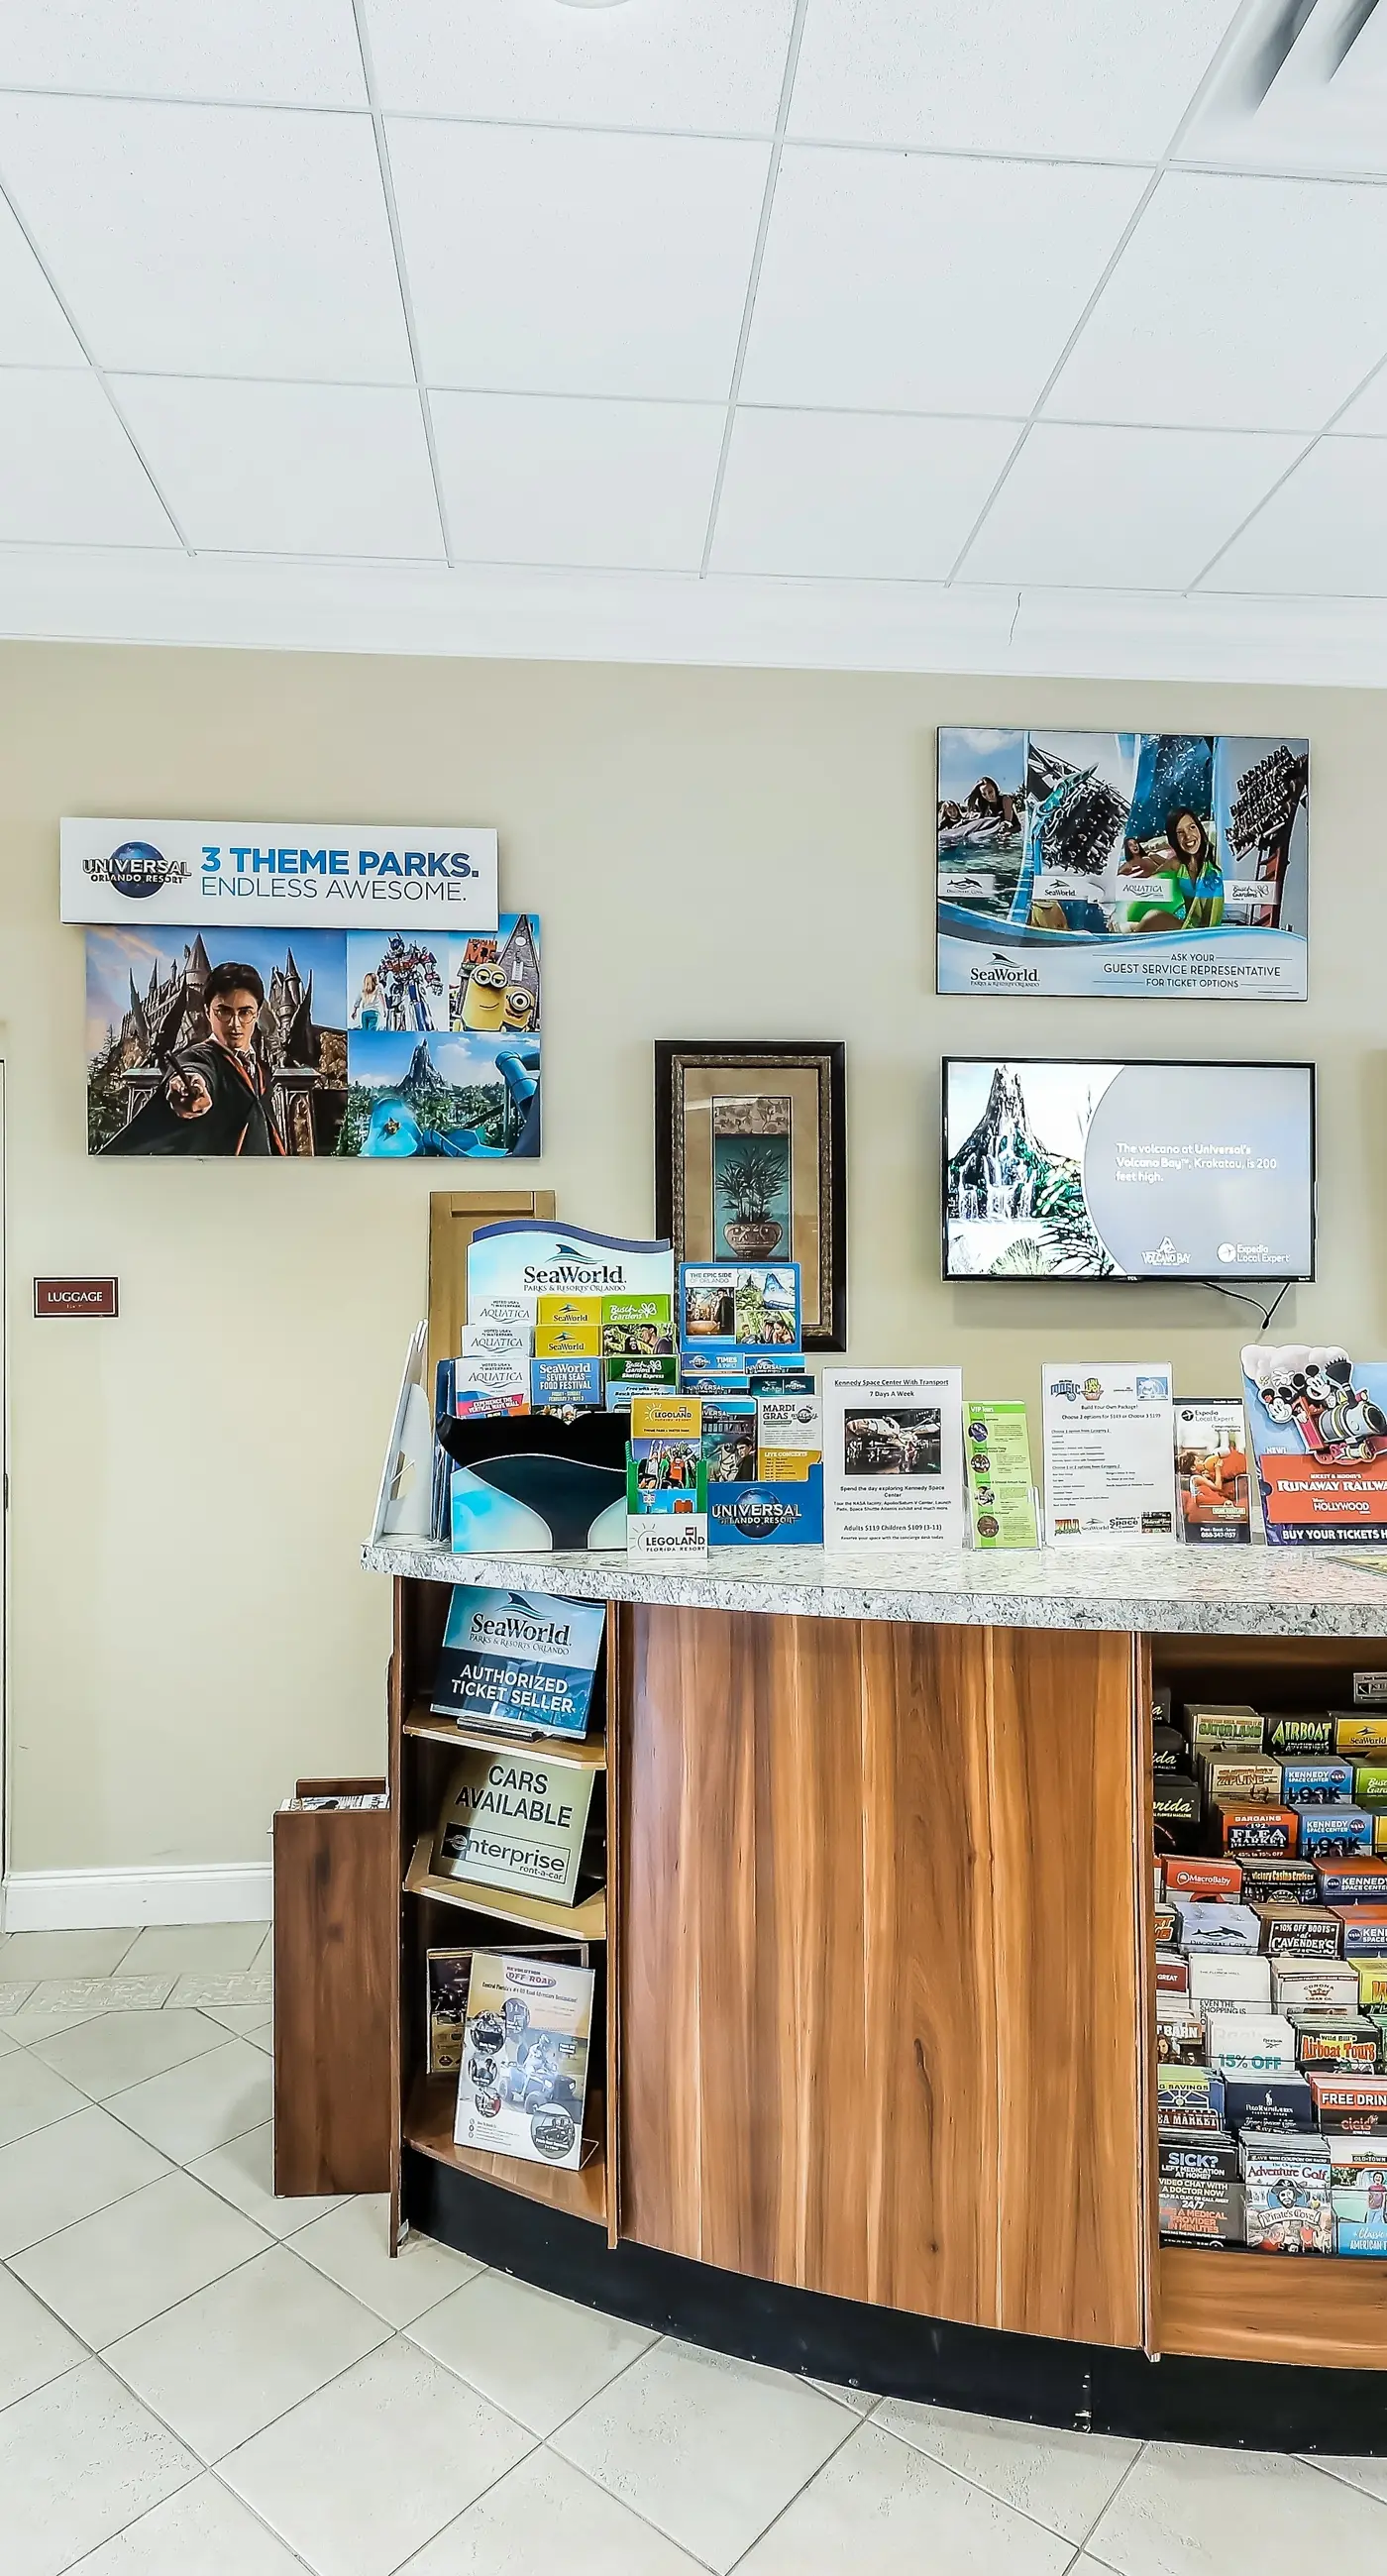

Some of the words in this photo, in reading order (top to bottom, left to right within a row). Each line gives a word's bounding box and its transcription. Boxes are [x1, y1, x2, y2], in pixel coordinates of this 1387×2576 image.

[82, 858, 192, 877] UNIVERSAL
[200, 847, 221, 873] 3
[230, 848, 350, 876] THEME
[359, 851, 480, 878] PARKS.
[90, 874, 143, 884] ORLANDO
[144, 875, 184, 885] RESORT
[201, 878, 318, 899] ENDLESS
[325, 879, 468, 902] AWESOME.
[1122, 884, 1163, 893] AQUATICA
[1170, 953, 1187, 962] ASK
[1189, 953, 1216, 962] YOUR
[1104, 963, 1139, 975] GUEST
[1142, 964, 1188, 976] SERVICE
[1190, 965, 1281, 977] REPRESENTATIVE
[1146, 979, 1164, 988] FOR
[1166, 979, 1197, 988] TICKET
[1199, 979, 1239, 989] OPTIONS
[1116, 1143, 1137, 1154] The
[1138, 1143, 1180, 1154] volcano
[1182, 1144, 1193, 1154] at
[1195, 1144, 1251, 1155] Universal's
[1116, 1157, 1159, 1168] Volcano
[1194, 1158, 1245, 1170] Krakatau,
[1246, 1158, 1254, 1169] is
[1256, 1158, 1277, 1169] 200
[1116, 1171, 1136, 1182] feet
[1138, 1171, 1164, 1184] high.
[1236, 1244, 1269, 1254] Expedia
[1262, 1255, 1290, 1264] Expert
[48, 1292, 103, 1302] LUGGAGE
[480, 1309, 530, 1319] AQUATICA
[471, 1339, 523, 1347] AQUATICA
[540, 1363, 590, 1374] SeaWorld
[469, 1372, 523, 1382] AQUATICA
[654, 1410, 693, 1419] LEGOLAND
[1277, 1480, 1339, 1491] RUNAWAY
[711, 1504, 802, 1518] UNIVERSAL
[1314, 1502, 1370, 1511] HOLLYWOOD
[1283, 1531, 1304, 1540] BUY
[1306, 1530, 1335, 1540] YOUR
[1336, 1530, 1380, 1540] TICKETS
[646, 1536, 705, 1546] LEGOLAND
[470, 1633, 491, 1645] PARKS
[500, 1639, 531, 1652] RESORTS
[533, 1643, 570, 1656] ORLANDO
[460, 1664, 569, 1694] AUTHORIZED
[452, 1679, 507, 1701] TICKET
[1272, 1720, 1332, 1745] AIRBOAT
[488, 1766, 549, 1794] CARS
[455, 1786, 573, 1828] AVAILABLE
[1230, 1829, 1286, 1840] FLEA
[451, 1834, 565, 1872] enterprise
[1189, 1875, 1231, 1885] MacroBaby
[1308, 1924, 1331, 1934] BOOTS
[1272, 1938, 1335, 1954] CAVENDER'S
[529, 1976, 554, 1986] ROAD
[1164, 2026, 1199, 2038] BARN
[1302, 2036, 1341, 2060] Airboat
[1343, 2043, 1375, 2061] Tours
[1219, 2054, 1248, 2069] 15%
[1251, 2056, 1282, 2070] OFF
[1322, 2093, 1354, 2104] FREE
[1357, 2094, 1387, 2106] DRIN
[1168, 2153, 1219, 2168] SICK?
[1180, 2166, 1226, 2176] MEDICATION
[1247, 2166, 1300, 2178] Adventure
[1302, 2167, 1327, 2180] Golf
[1158, 2178, 1183, 2187] VIDEO
[1170, 2187, 1203, 2197] DOCTOR
[1204, 2189, 1225, 2198] NOW
[1182, 2200, 1205, 2209] 24/7
[1263, 2210, 1293, 2221] Pirate's
[1350, 2240, 1381, 2250] AMERICAN
